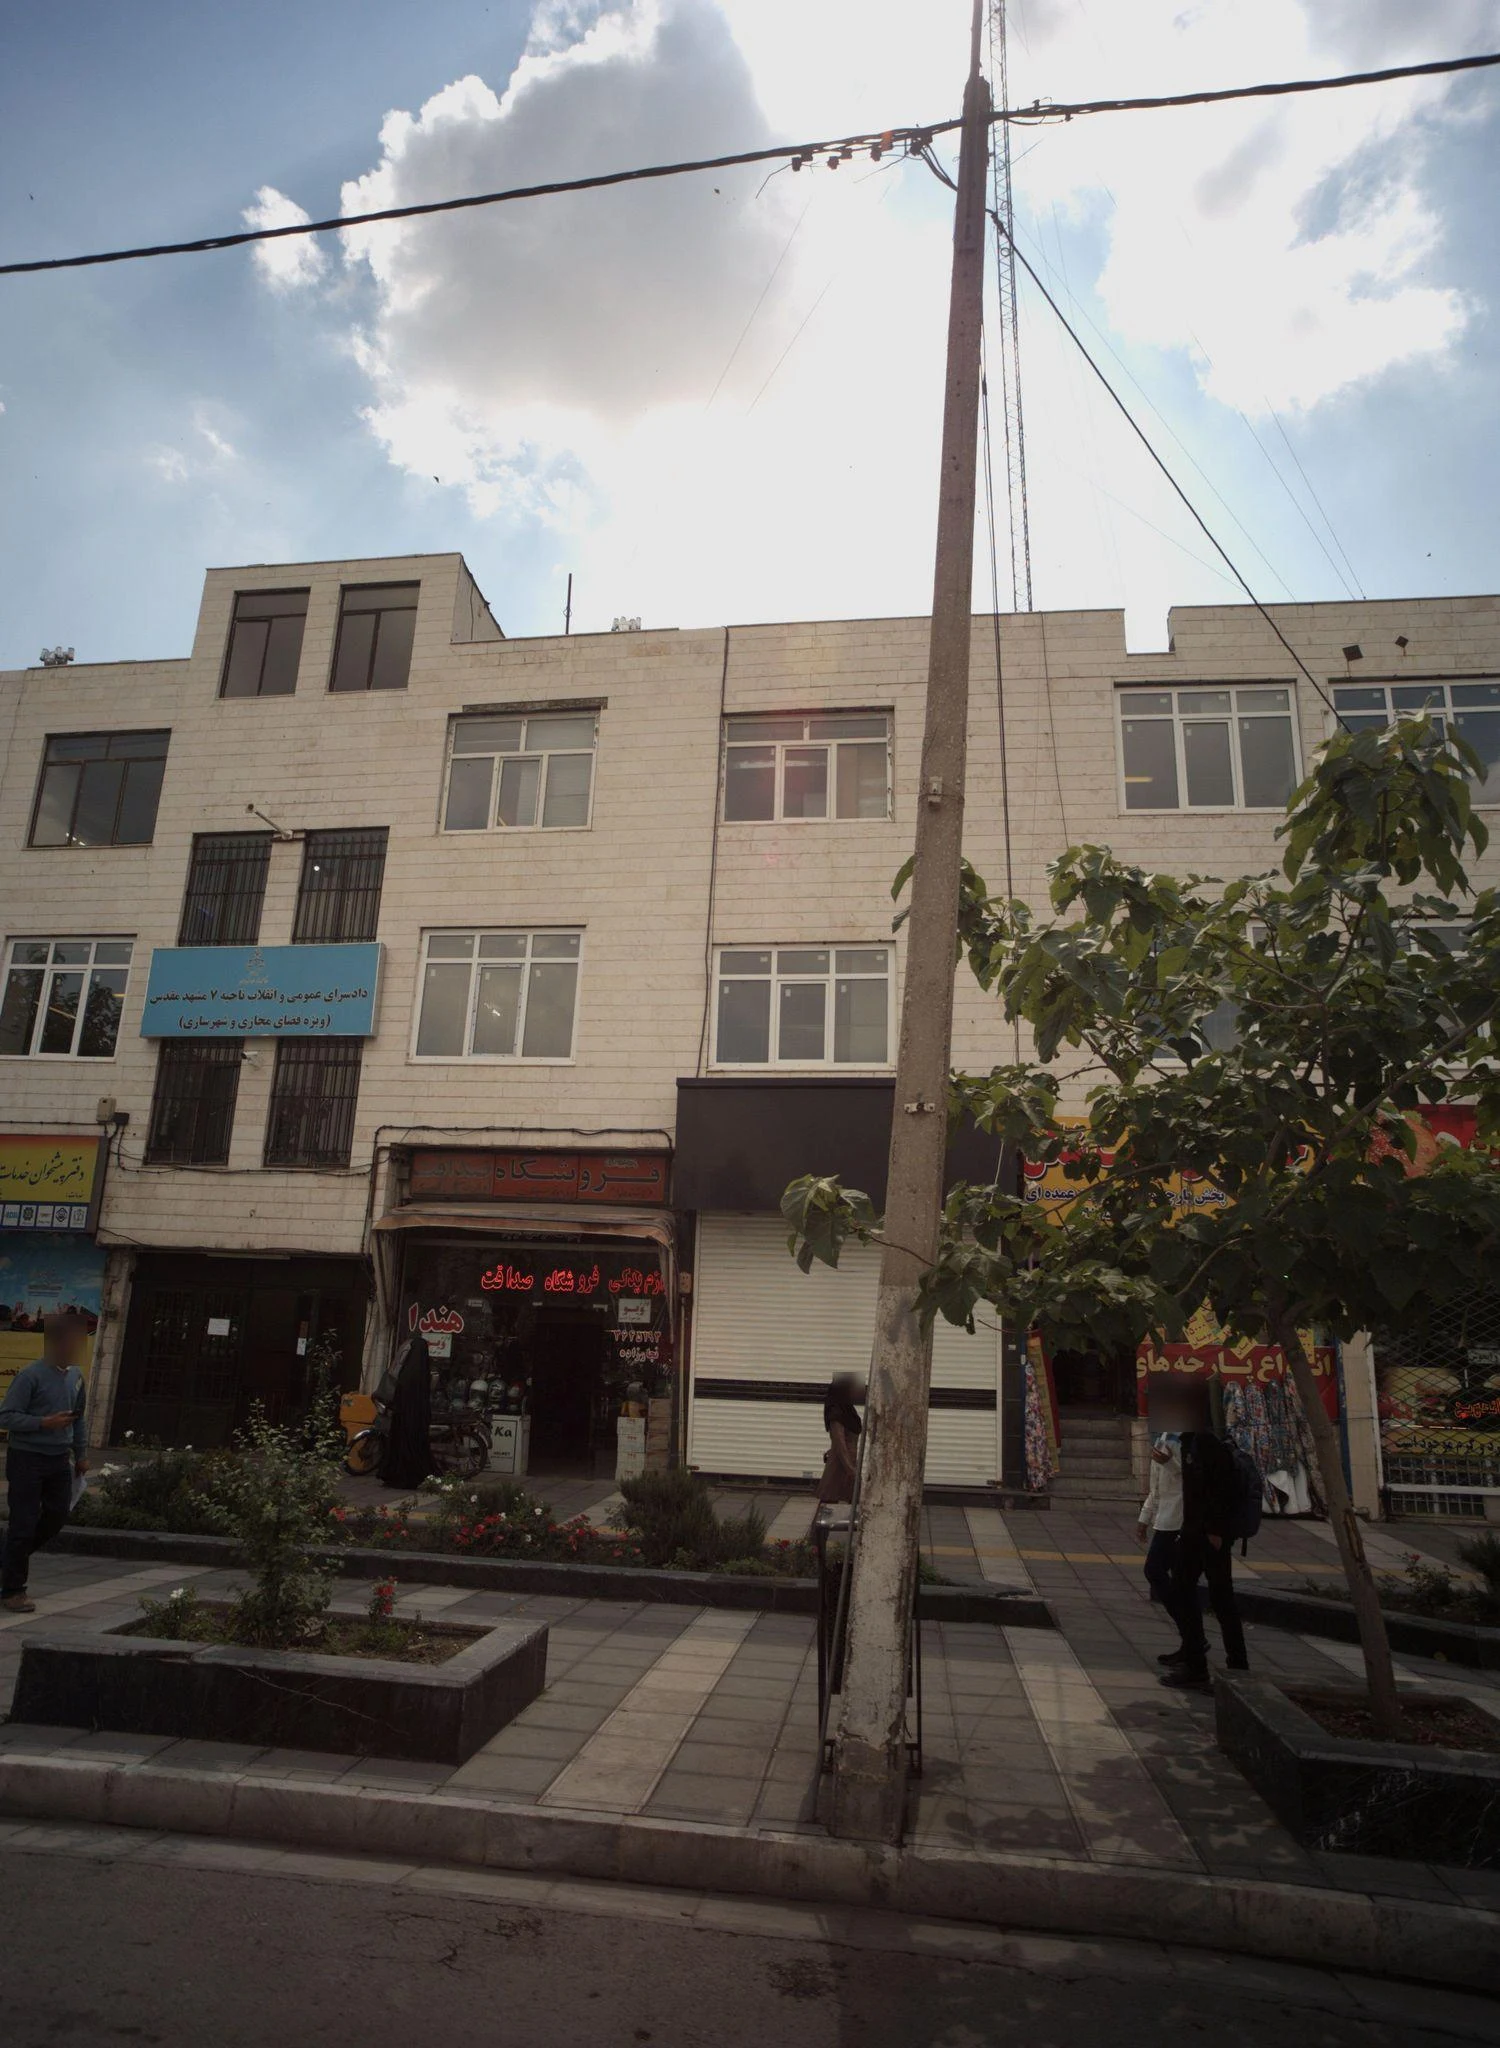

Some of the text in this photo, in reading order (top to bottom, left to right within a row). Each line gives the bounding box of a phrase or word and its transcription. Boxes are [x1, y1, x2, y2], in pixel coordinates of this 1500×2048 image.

[150, 990, 180, 1005] مقدس
[210, 989, 218, 1000] ۷
[246, 988, 277, 1002] انقلاب
[279, 993, 285, 1004] و
[286, 990, 322, 1004] عمومی
[323, 988, 369, 1003] دادسرای
[229, 1018, 236, 1030] و
[238, 1015, 271, 1030] مجازی
[1193, 1186, 1226, 1207] پخش
[408, 1301, 465, 1335] هندا
